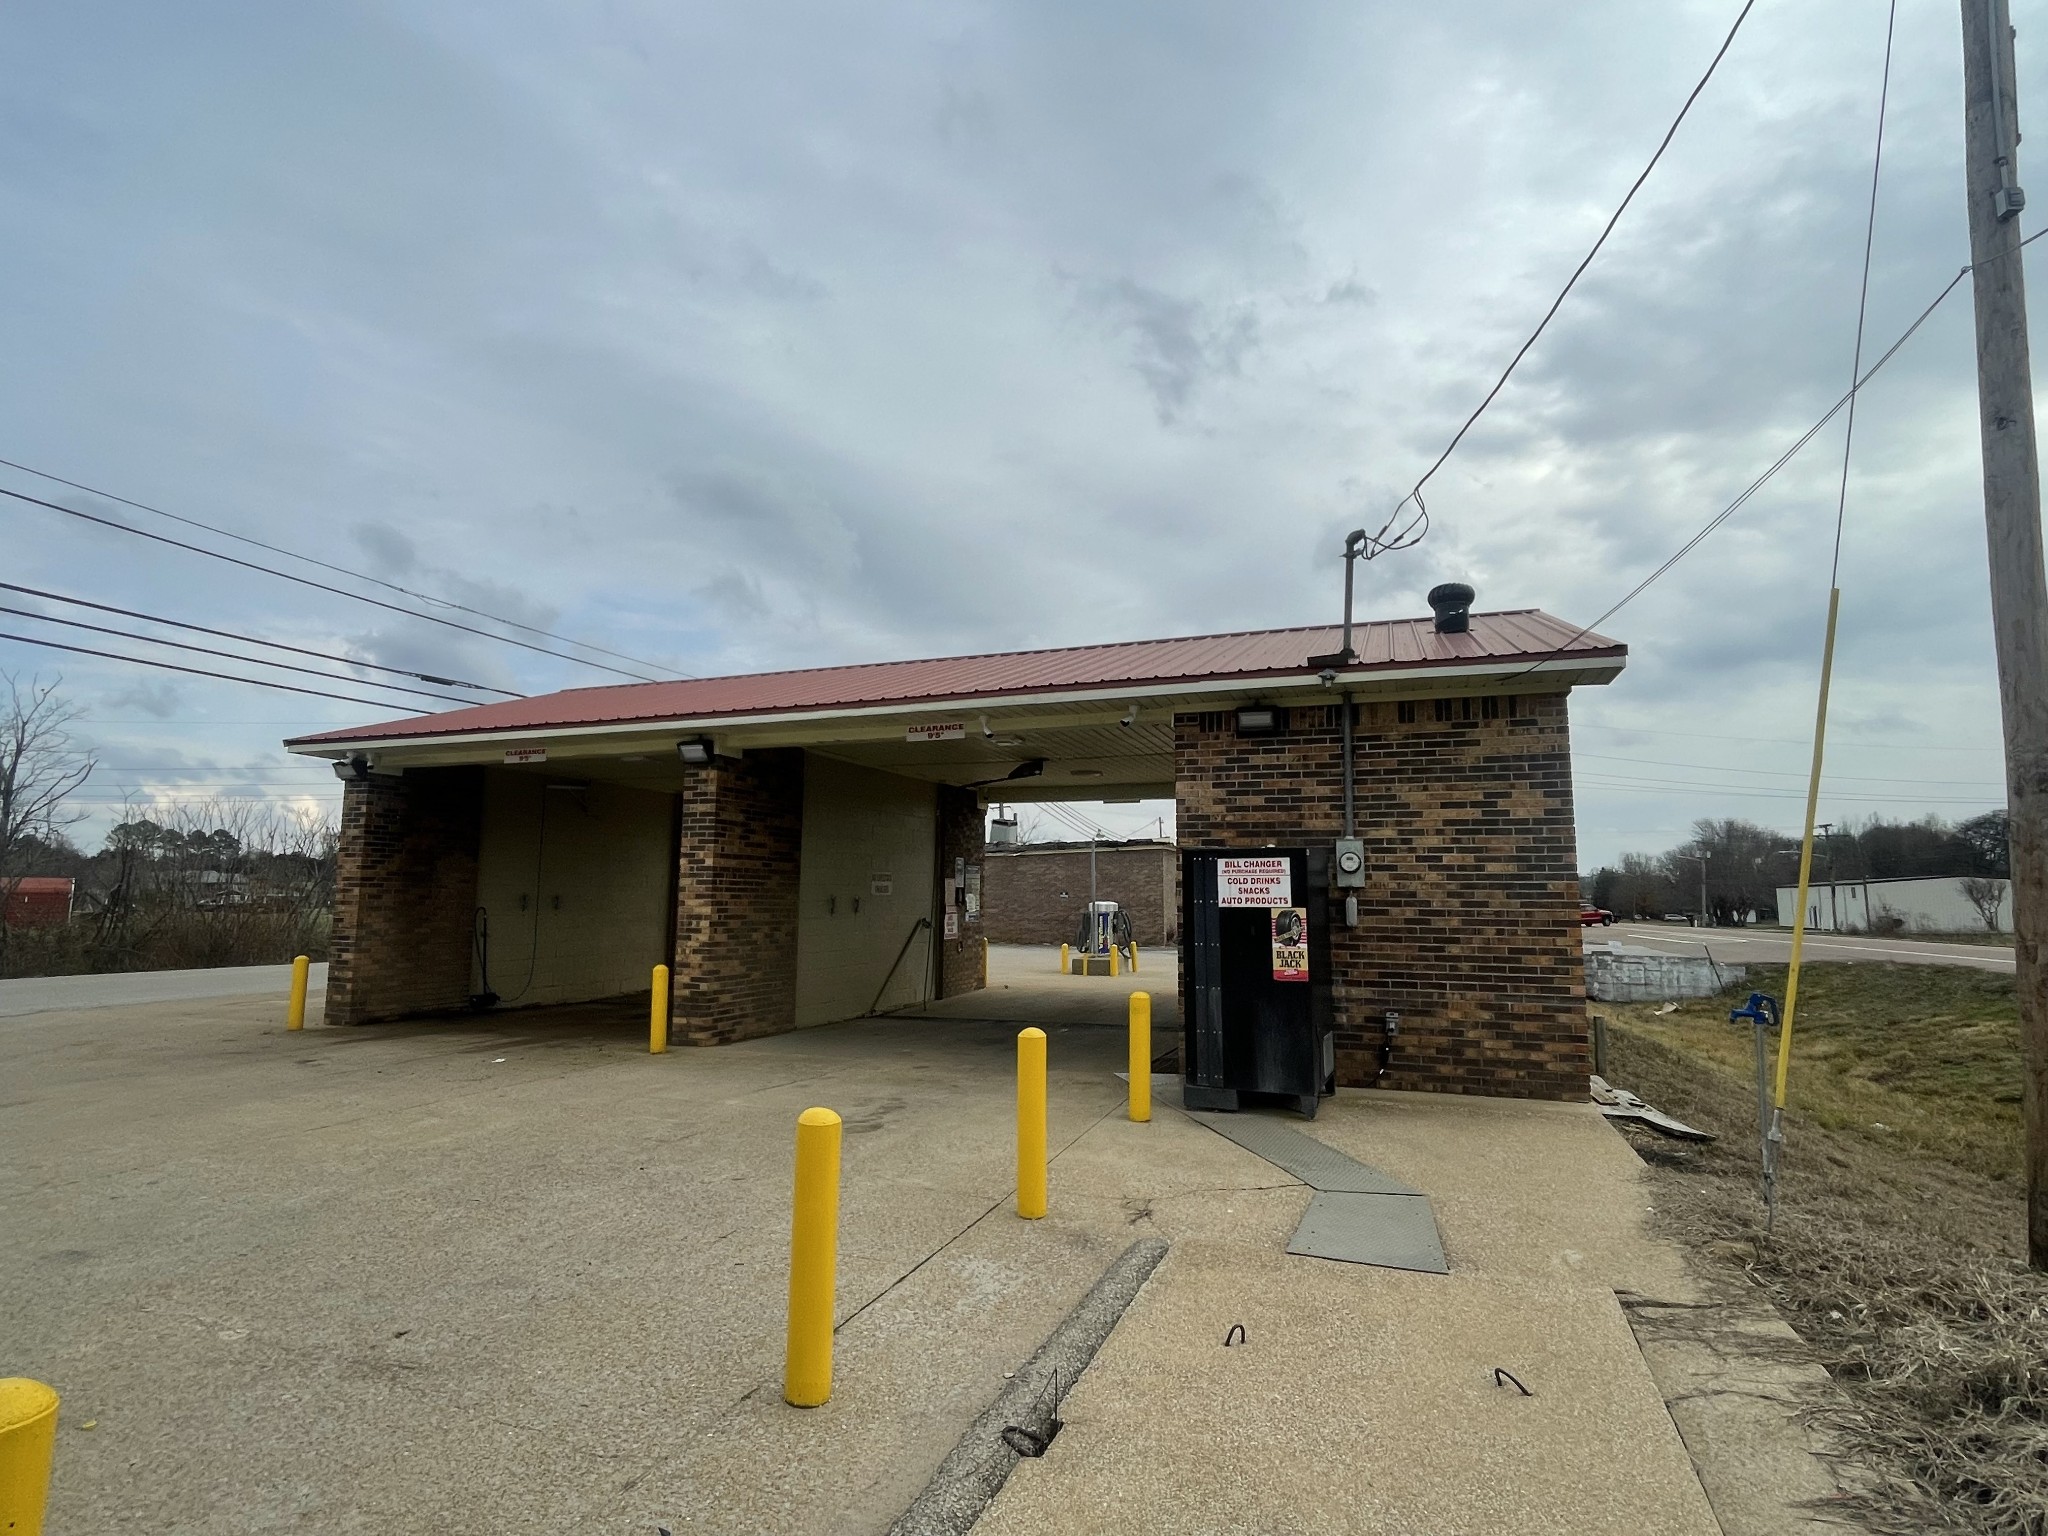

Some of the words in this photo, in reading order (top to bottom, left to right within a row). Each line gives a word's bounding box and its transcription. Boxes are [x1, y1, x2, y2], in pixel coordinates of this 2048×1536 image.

[908, 723, 964, 733] CLEARANCE
[1224, 860, 1241, 868] BILL
[1243, 860, 1282, 868] CHANGER
[1227, 877, 1248, 885] COLD
[1250, 877, 1281, 885] DRINKS
[1238, 887, 1270, 895] SNACKS
[1245, 897, 1288, 905] PRODUCTS
[1276, 950, 1305, 959] BLACK
[1279, 959, 1301, 968] JACK
